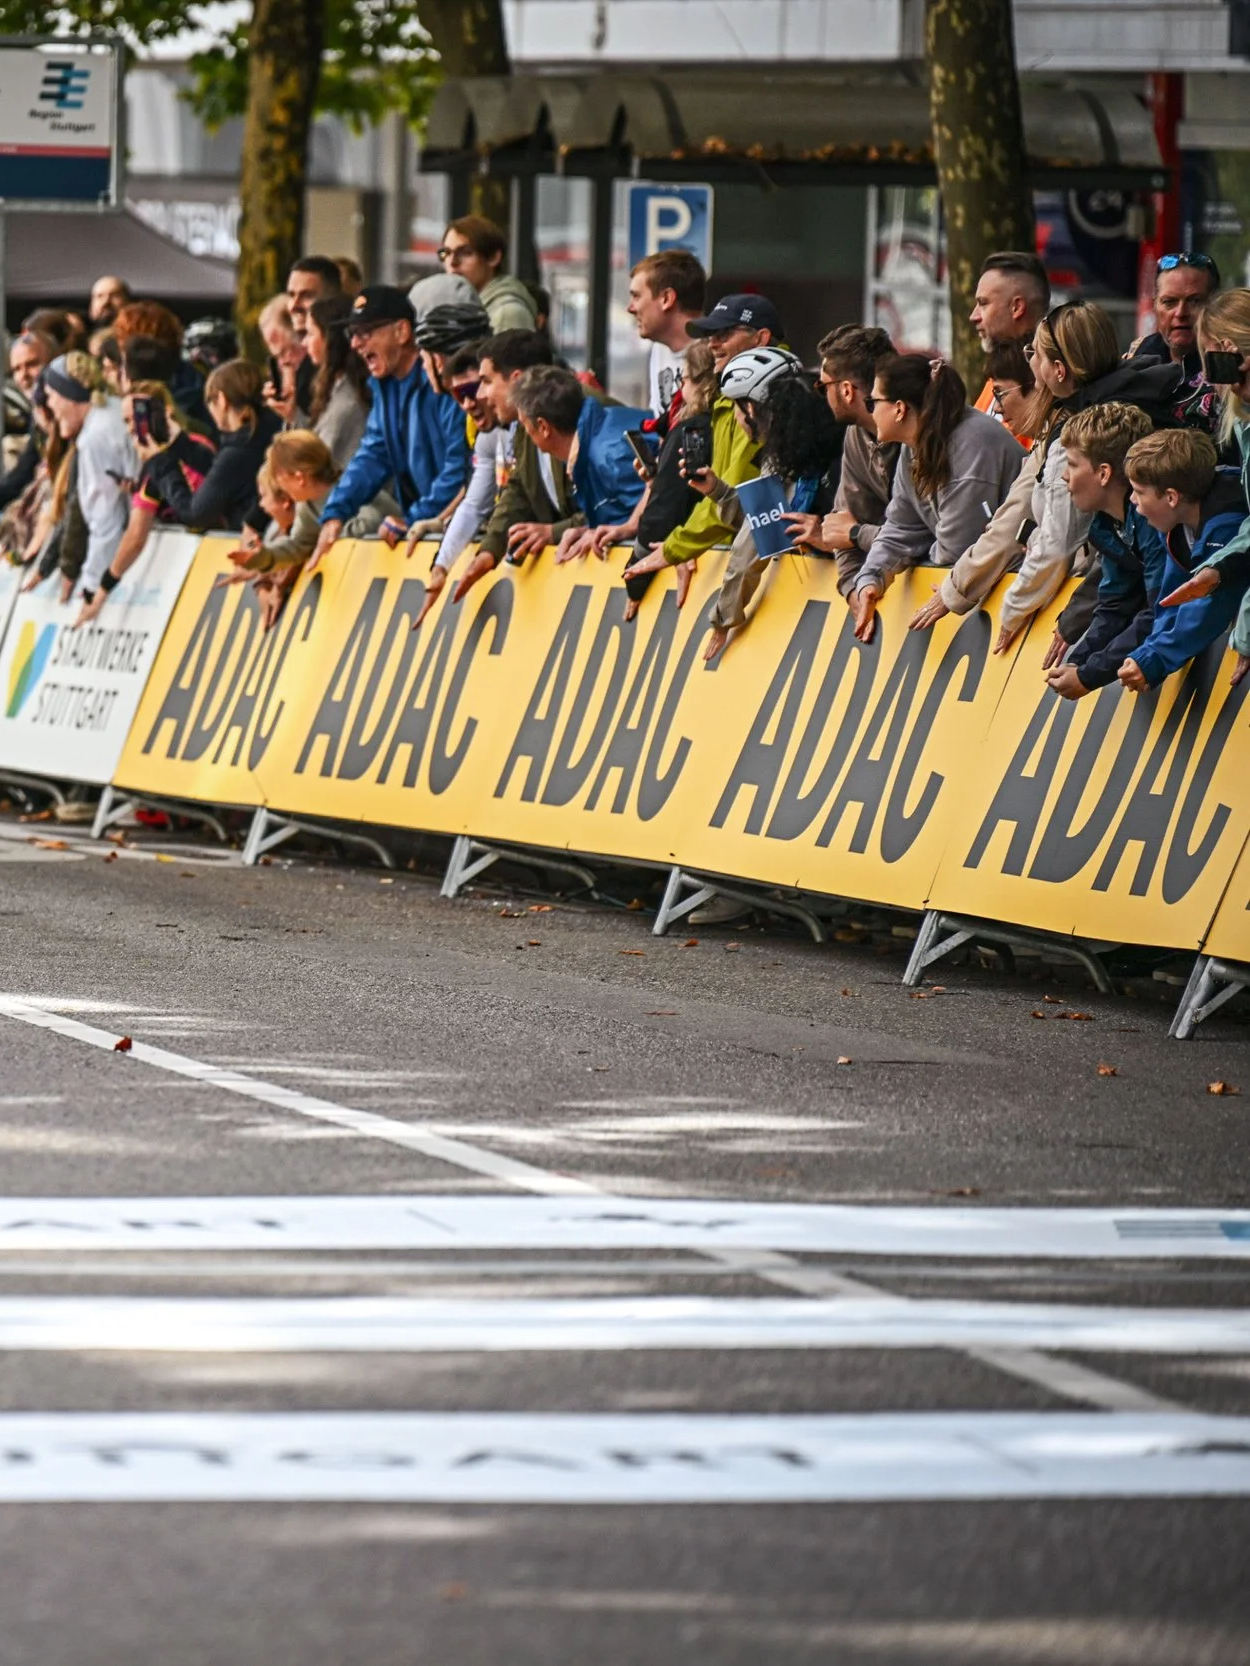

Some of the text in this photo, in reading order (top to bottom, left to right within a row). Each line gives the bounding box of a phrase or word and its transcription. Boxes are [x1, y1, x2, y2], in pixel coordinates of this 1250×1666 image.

[49, 121, 96, 133] Stuttgart
[646, 195, 692, 257] P
[31, 683, 118, 732] STUTTGART
[52, 624, 149, 673] STADTWERKE
[141, 572, 323, 772] ADAC
[294, 576, 515, 796] ADAC
[493, 584, 722, 821] ADAC
[708, 600, 992, 864] ADAC
[963, 633, 1250, 905] ADAC
